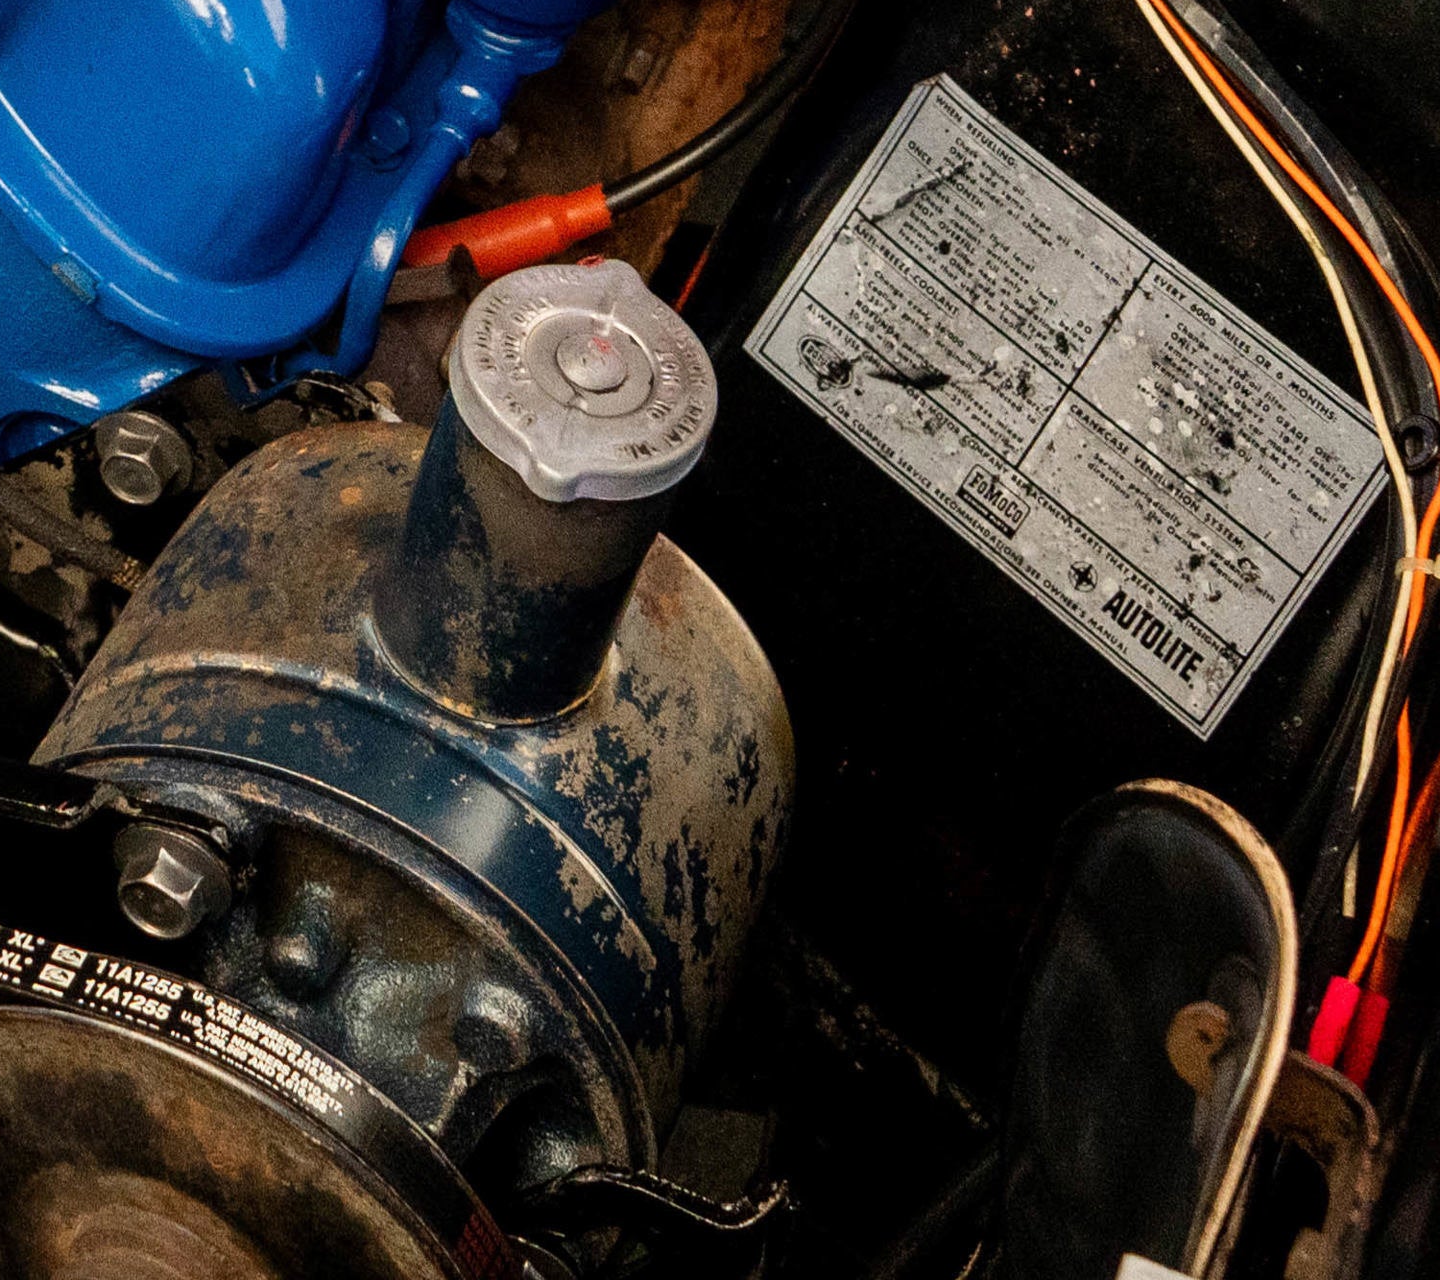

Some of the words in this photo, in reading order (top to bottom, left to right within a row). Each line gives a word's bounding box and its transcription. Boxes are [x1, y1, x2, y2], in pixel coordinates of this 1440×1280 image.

[934, 95, 963, 122] WHEN
[906, 139, 932, 165] ONCE
[914, 200, 934, 219] NOT
[1076, 319, 1092, 335] DO
[1175, 320, 1211, 354] Change
[1153, 273, 1185, 304] EVERY
[1189, 301, 1217, 328] 6000
[1220, 325, 1251, 355] MILES
[1254, 353, 1272, 371] OR
[1288, 378, 1338, 424] MONTHS:
[1226, 373, 1271, 415] 10W-30
[1275, 413, 1309, 445] GRADE
[1069, 401, 1129, 456] CRANKCASE
[1132, 453, 1200, 514] VENTILATION
[926, 404, 961, 436] MOTOR
[1073, 526, 1103, 554] PARTS
[967, 470, 1025, 525] FoMoCo
[831, 400, 850, 419] FOR
[851, 417, 896, 458] COMPLETE
[897, 455, 932, 489] SERVICE
[933, 486, 1023, 566] RECOMMENDATIONS
[1024, 563, 1041, 581] SEE
[1042, 578, 1086, 618] OWNER'S
[1087, 616, 1129, 655] MANUAL
[82, 978, 172, 1021] 11A1255
[95, 957, 184, 1001] 11A1255
[241, 1013, 303, 1055] NUMBERS
[259, 1034, 286, 1057] AND
[247, 1054, 276, 1079] AND
